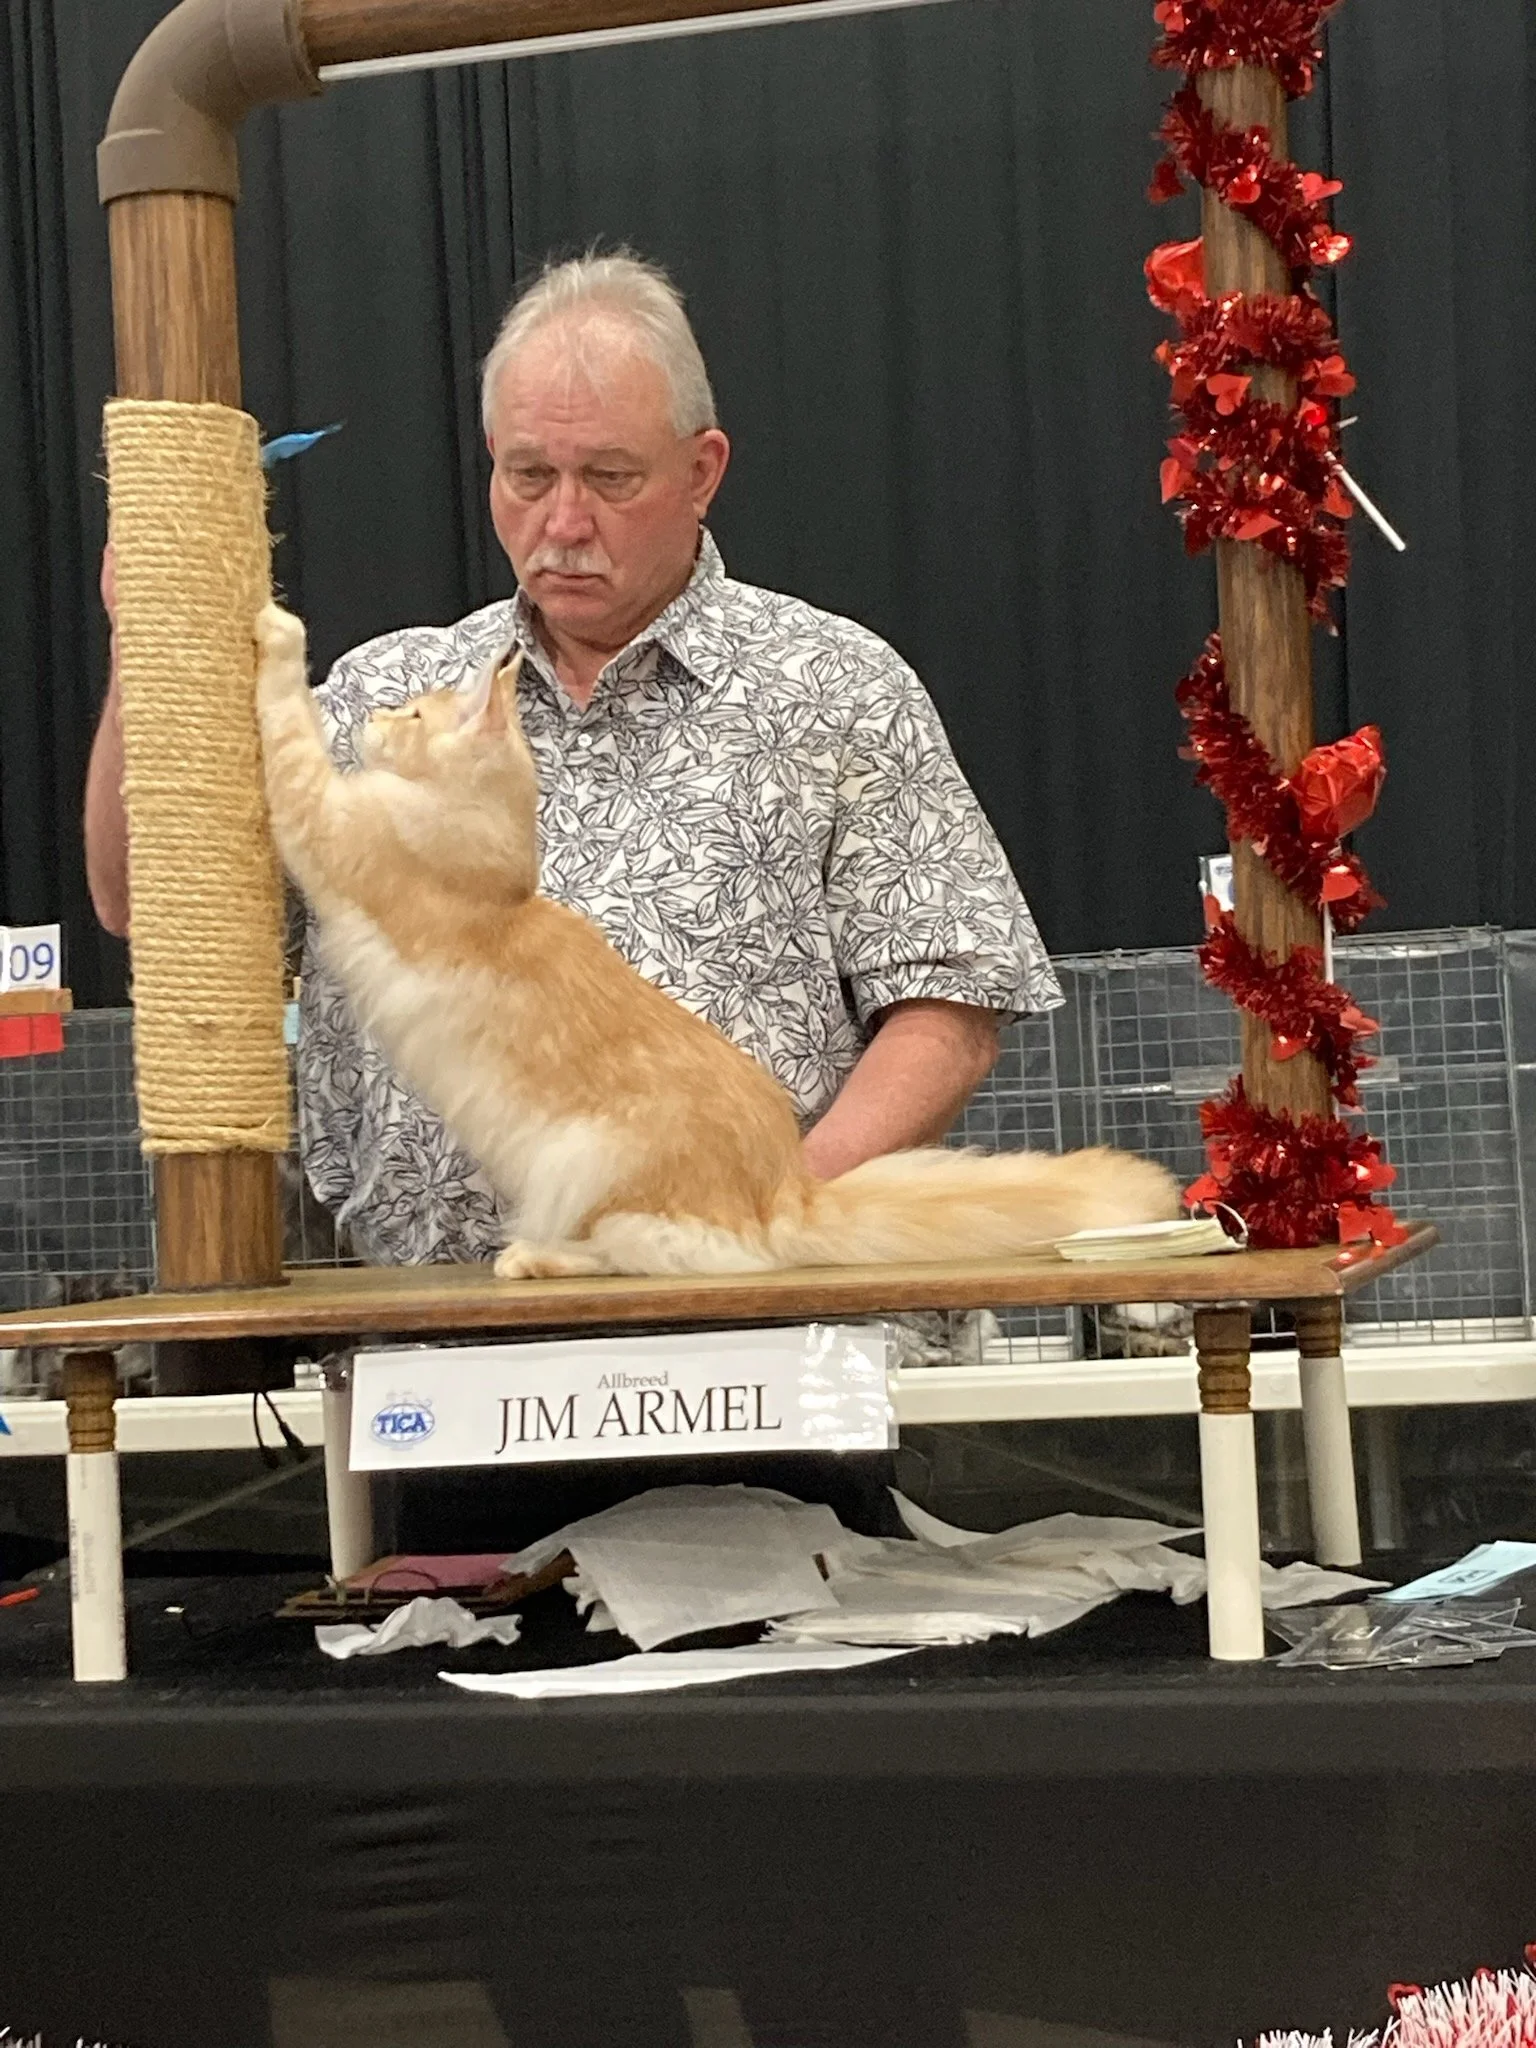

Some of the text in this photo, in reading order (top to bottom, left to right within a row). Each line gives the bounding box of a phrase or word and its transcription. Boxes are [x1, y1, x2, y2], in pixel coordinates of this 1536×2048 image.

[597, 1370, 669, 1389] Allbreed
[377, 1412, 427, 1434] TICA
[494, 1384, 782, 1455] JIM ARMEL
